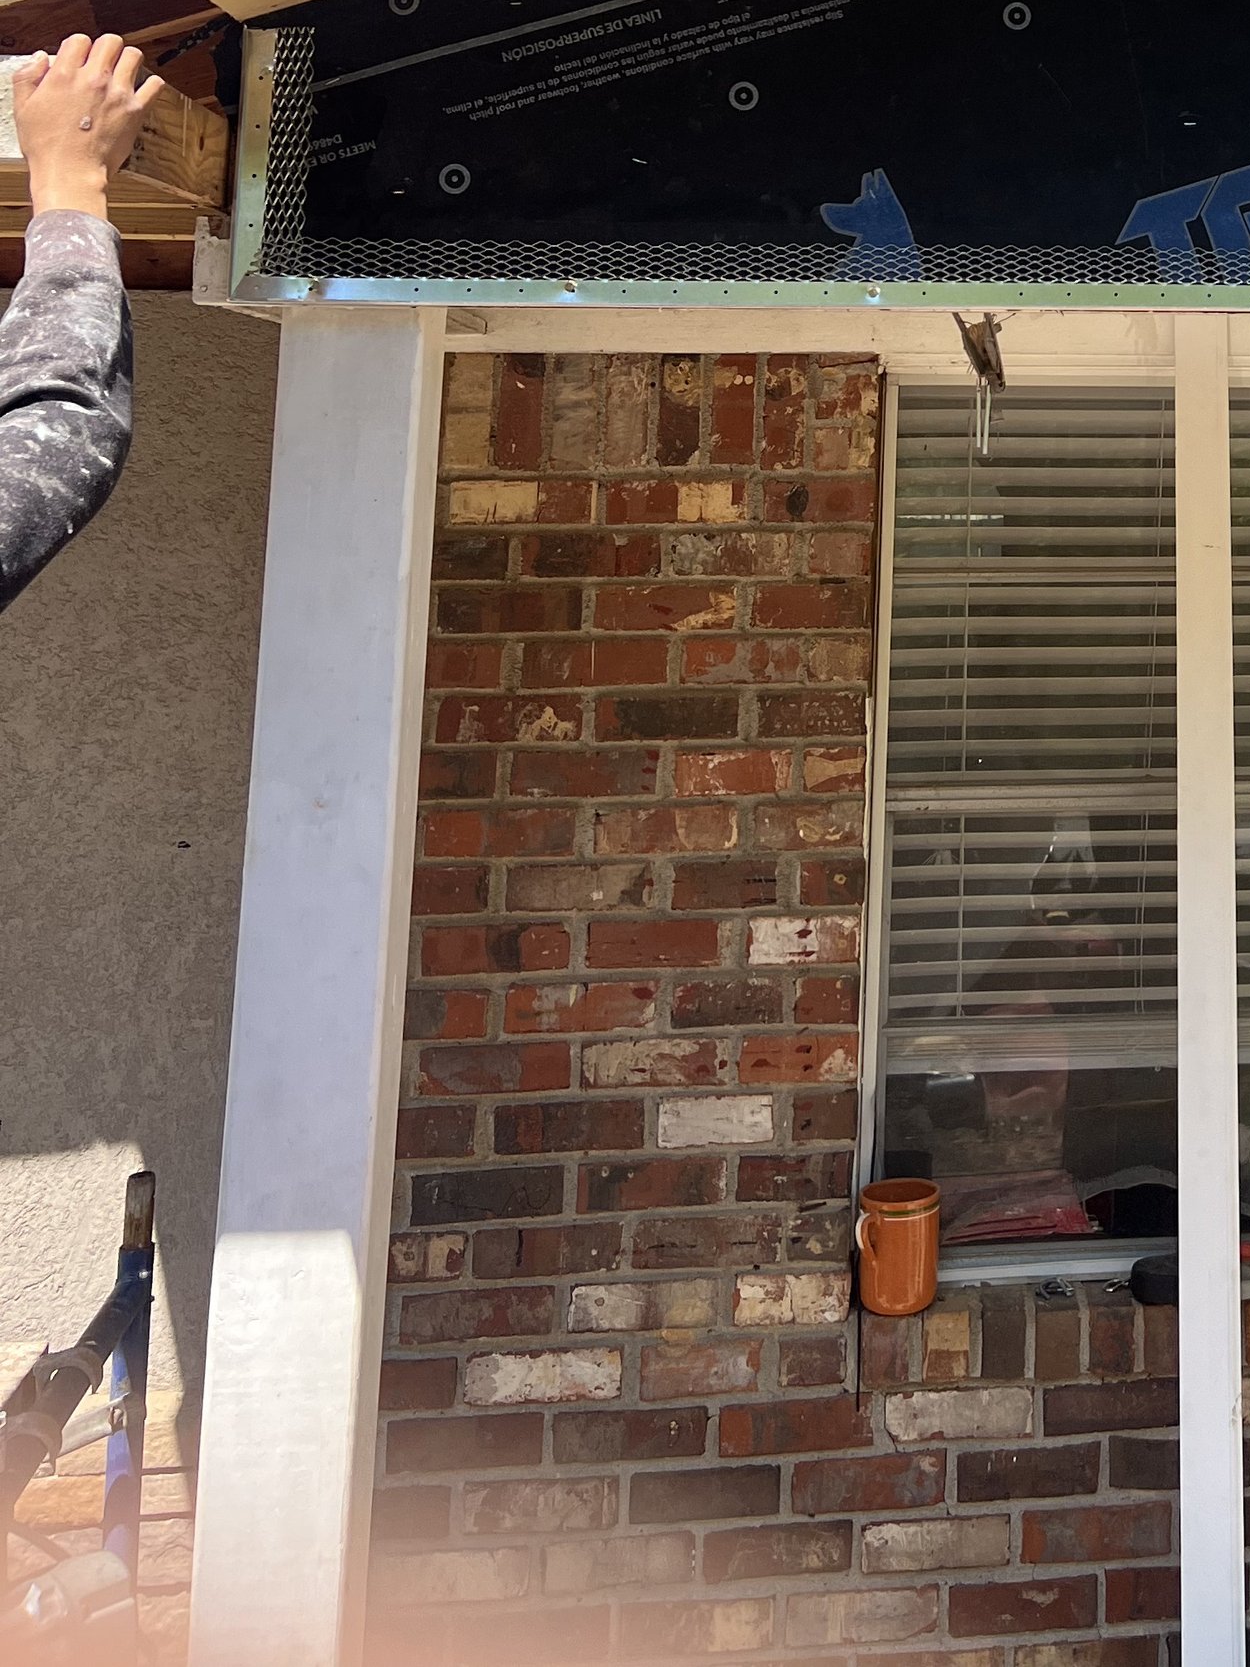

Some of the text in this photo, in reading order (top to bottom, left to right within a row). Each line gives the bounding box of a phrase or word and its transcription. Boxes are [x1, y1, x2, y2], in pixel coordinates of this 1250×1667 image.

[721, 15, 741, 25] tipo
[741, 12, 751, 22] el
[708, 21, 720, 29] de
[501, 9, 662, 62] LÍNEA DE SUPERPOSICIÓN
[469, 10, 844, 121] Slip resistance may vary with surface conditions, weather, footwear and roof pitch
[554, 59, 582, 72] techo
[583, 55, 598, 66] del
[338, 140, 376, 159] MEETS
[318, 152, 337, 164] OR
